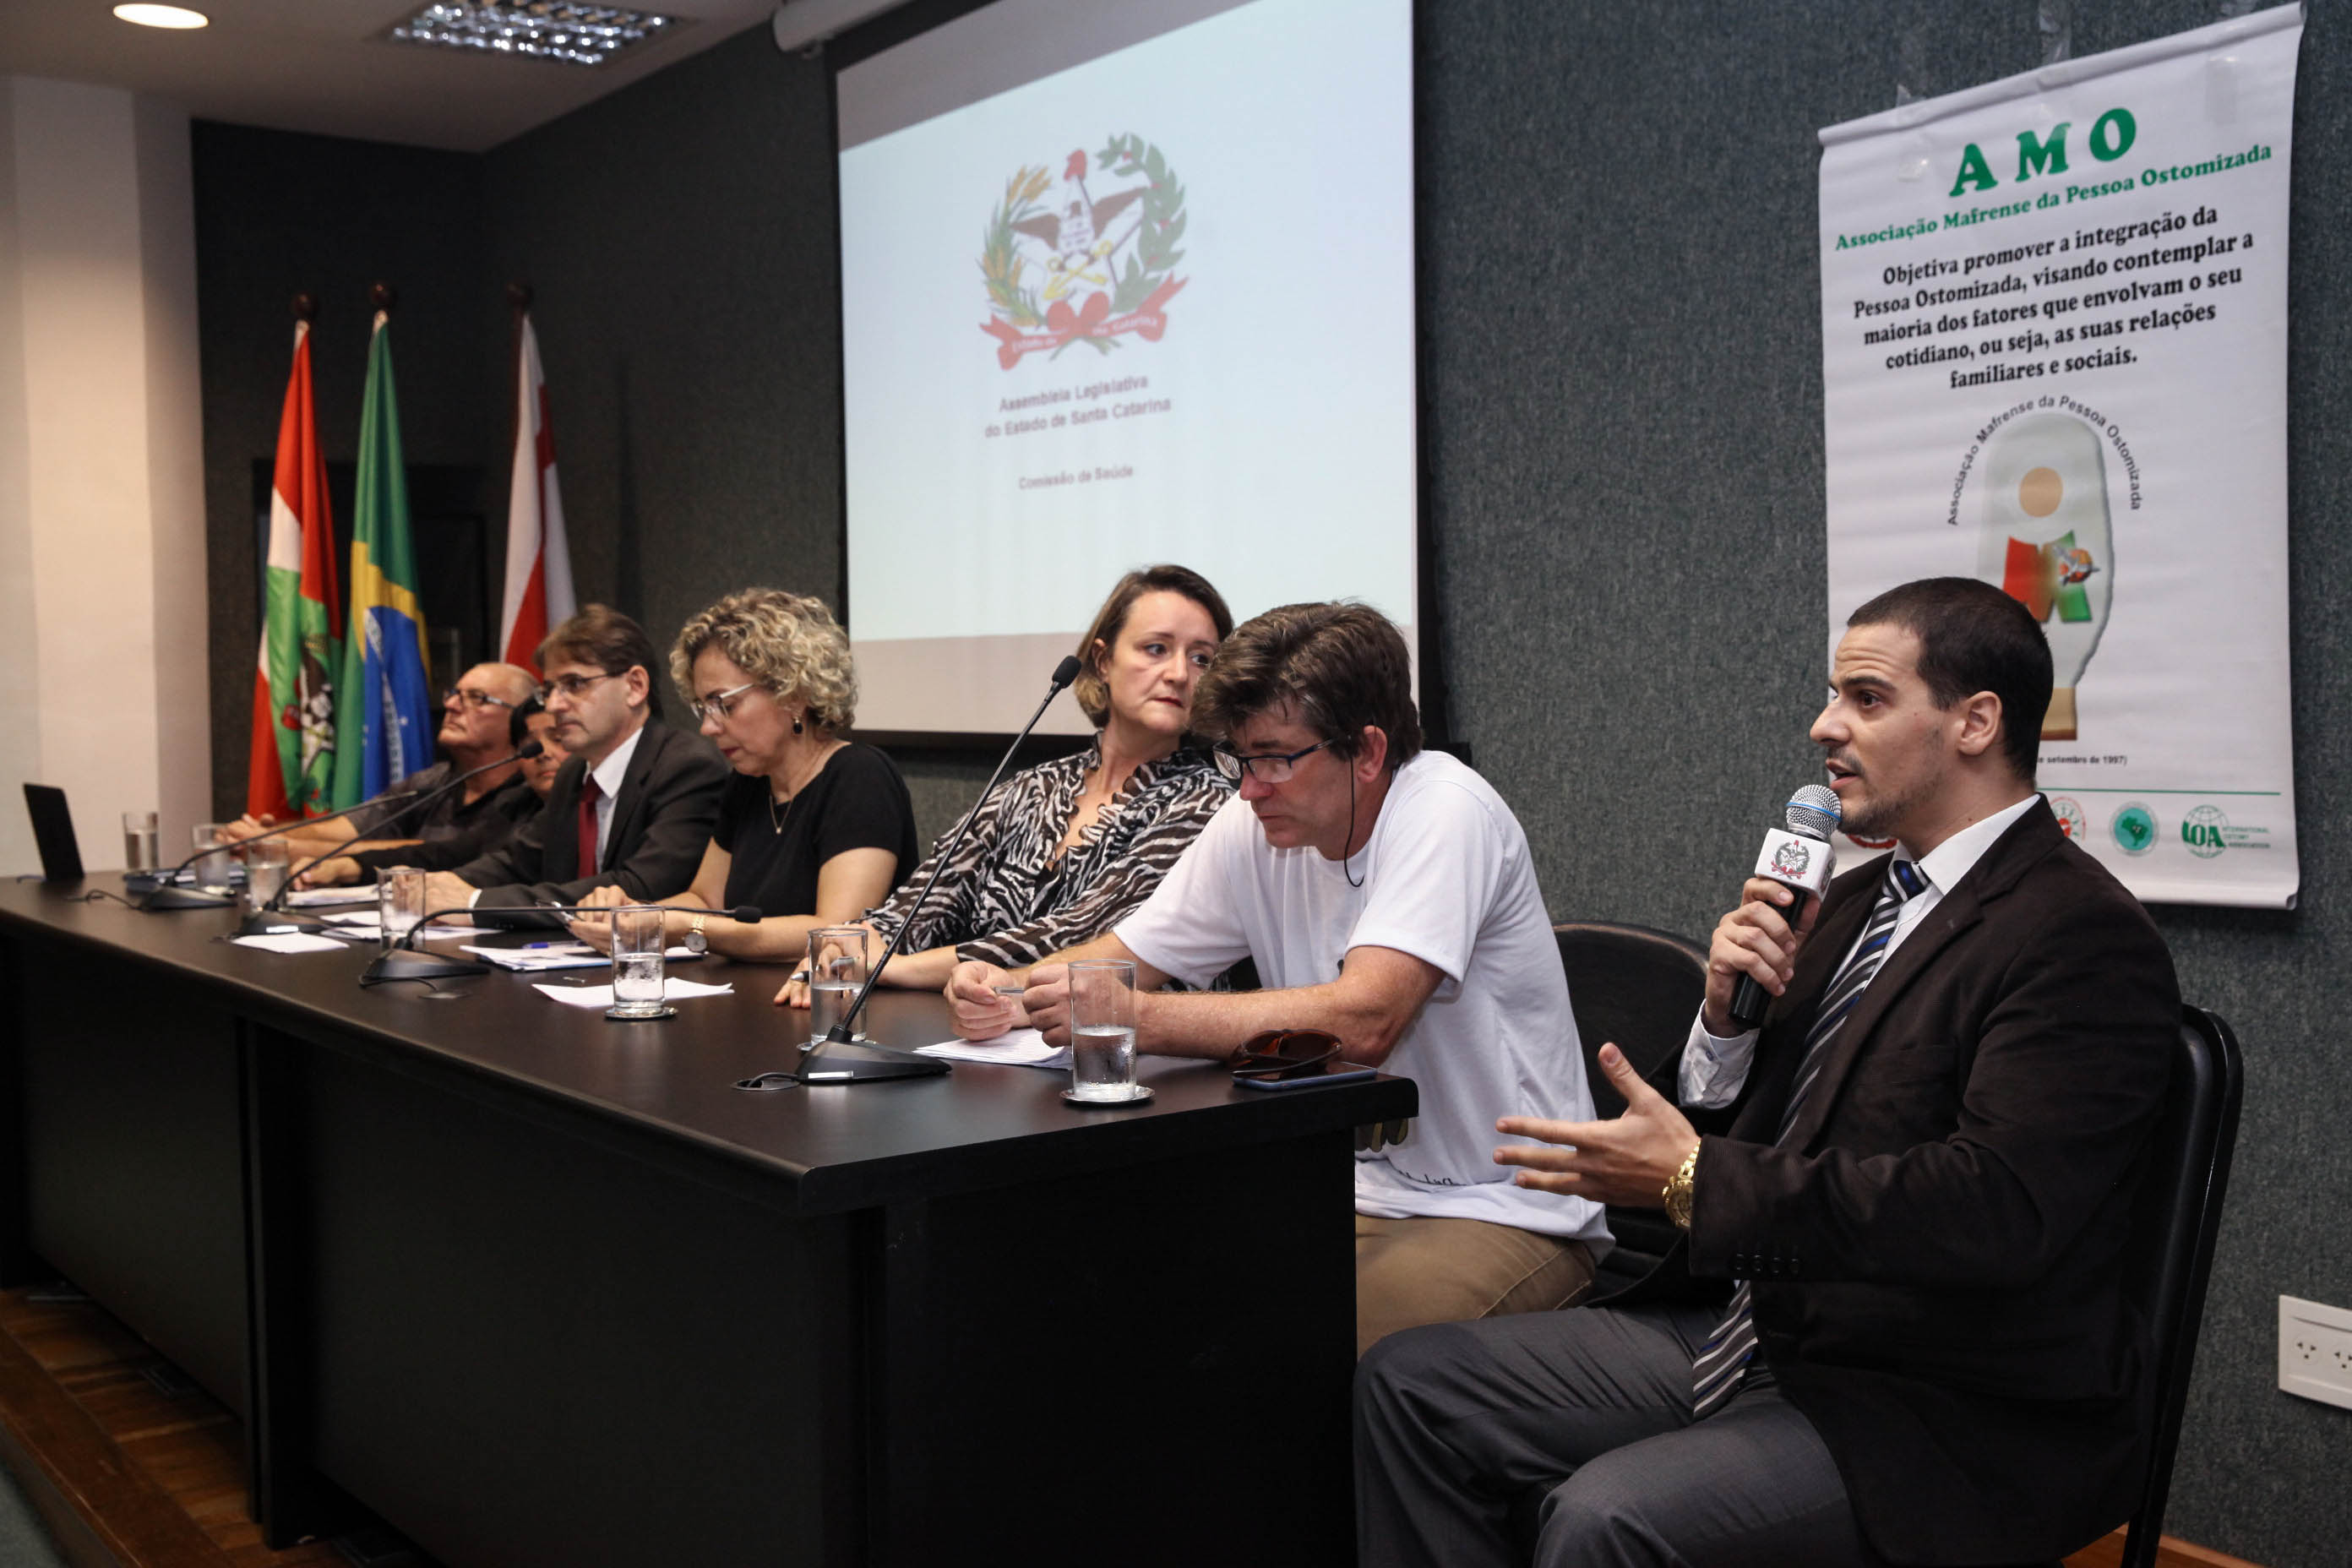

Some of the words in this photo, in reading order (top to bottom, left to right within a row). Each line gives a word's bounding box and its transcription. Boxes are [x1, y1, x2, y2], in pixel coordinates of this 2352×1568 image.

[1949, 108, 2137, 197] AMO
[1835, 218, 1938, 251] Associação
[1943, 199, 2032, 230] Mafrense
[2036, 192, 2060, 210] da
[2066, 177, 2135, 204] Pessoa
[2141, 144, 2273, 187] Ostomizada
[1854, 297, 1911, 319] Pessoa
[1915, 275, 2028, 308] Ostomizada,
[2033, 258, 2108, 286] visando
[2114, 236, 2238, 273] contemplar
[2242, 232, 2254, 248] a
[1882, 259, 1958, 286] Objetiva
[1963, 239, 2055, 275] promover
[2059, 237, 2070, 252] a
[2075, 212, 2186, 247] integração
[2192, 205, 2218, 227] da
[1864, 319, 1933, 345] maioria
[1937, 315, 1968, 333] dos
[1973, 303, 2038, 328] fatores
[2043, 297, 2078, 319] que
[2083, 281, 2183, 308] envolvam
[2189, 275, 2201, 291] o
[2207, 267, 2242, 288] seu
[1886, 344, 1975, 369] cotidiano,
[1979, 339, 2002, 355] ou
[2007, 332, 2050, 354] seja,
[2055, 327, 2074, 344] as
[2080, 319, 2123, 340] suas
[2129, 302, 2217, 332] relações
[999, 389, 1071, 412] Assembleia
[1075, 376, 1149, 400] Legislativa
[1950, 361, 2044, 389] familiares
[2050, 359, 2060, 374] e
[2065, 346, 2138, 373] sociais.
[984, 424, 1001, 438] do
[1004, 416, 1048, 436] Estado
[1051, 414, 1066, 428] de
[1071, 408, 1108, 425] Santa
[1112, 398, 1172, 419] Catarina
[1078, 470, 1092, 483] de
[1947, 444, 1979, 525] Associação
[1976, 400, 2034, 444] Mafrense
[2038, 395, 2055, 408] da
[2059, 395, 2107, 427] Pessoa
[2106, 424, 2142, 511] Ostomizada
